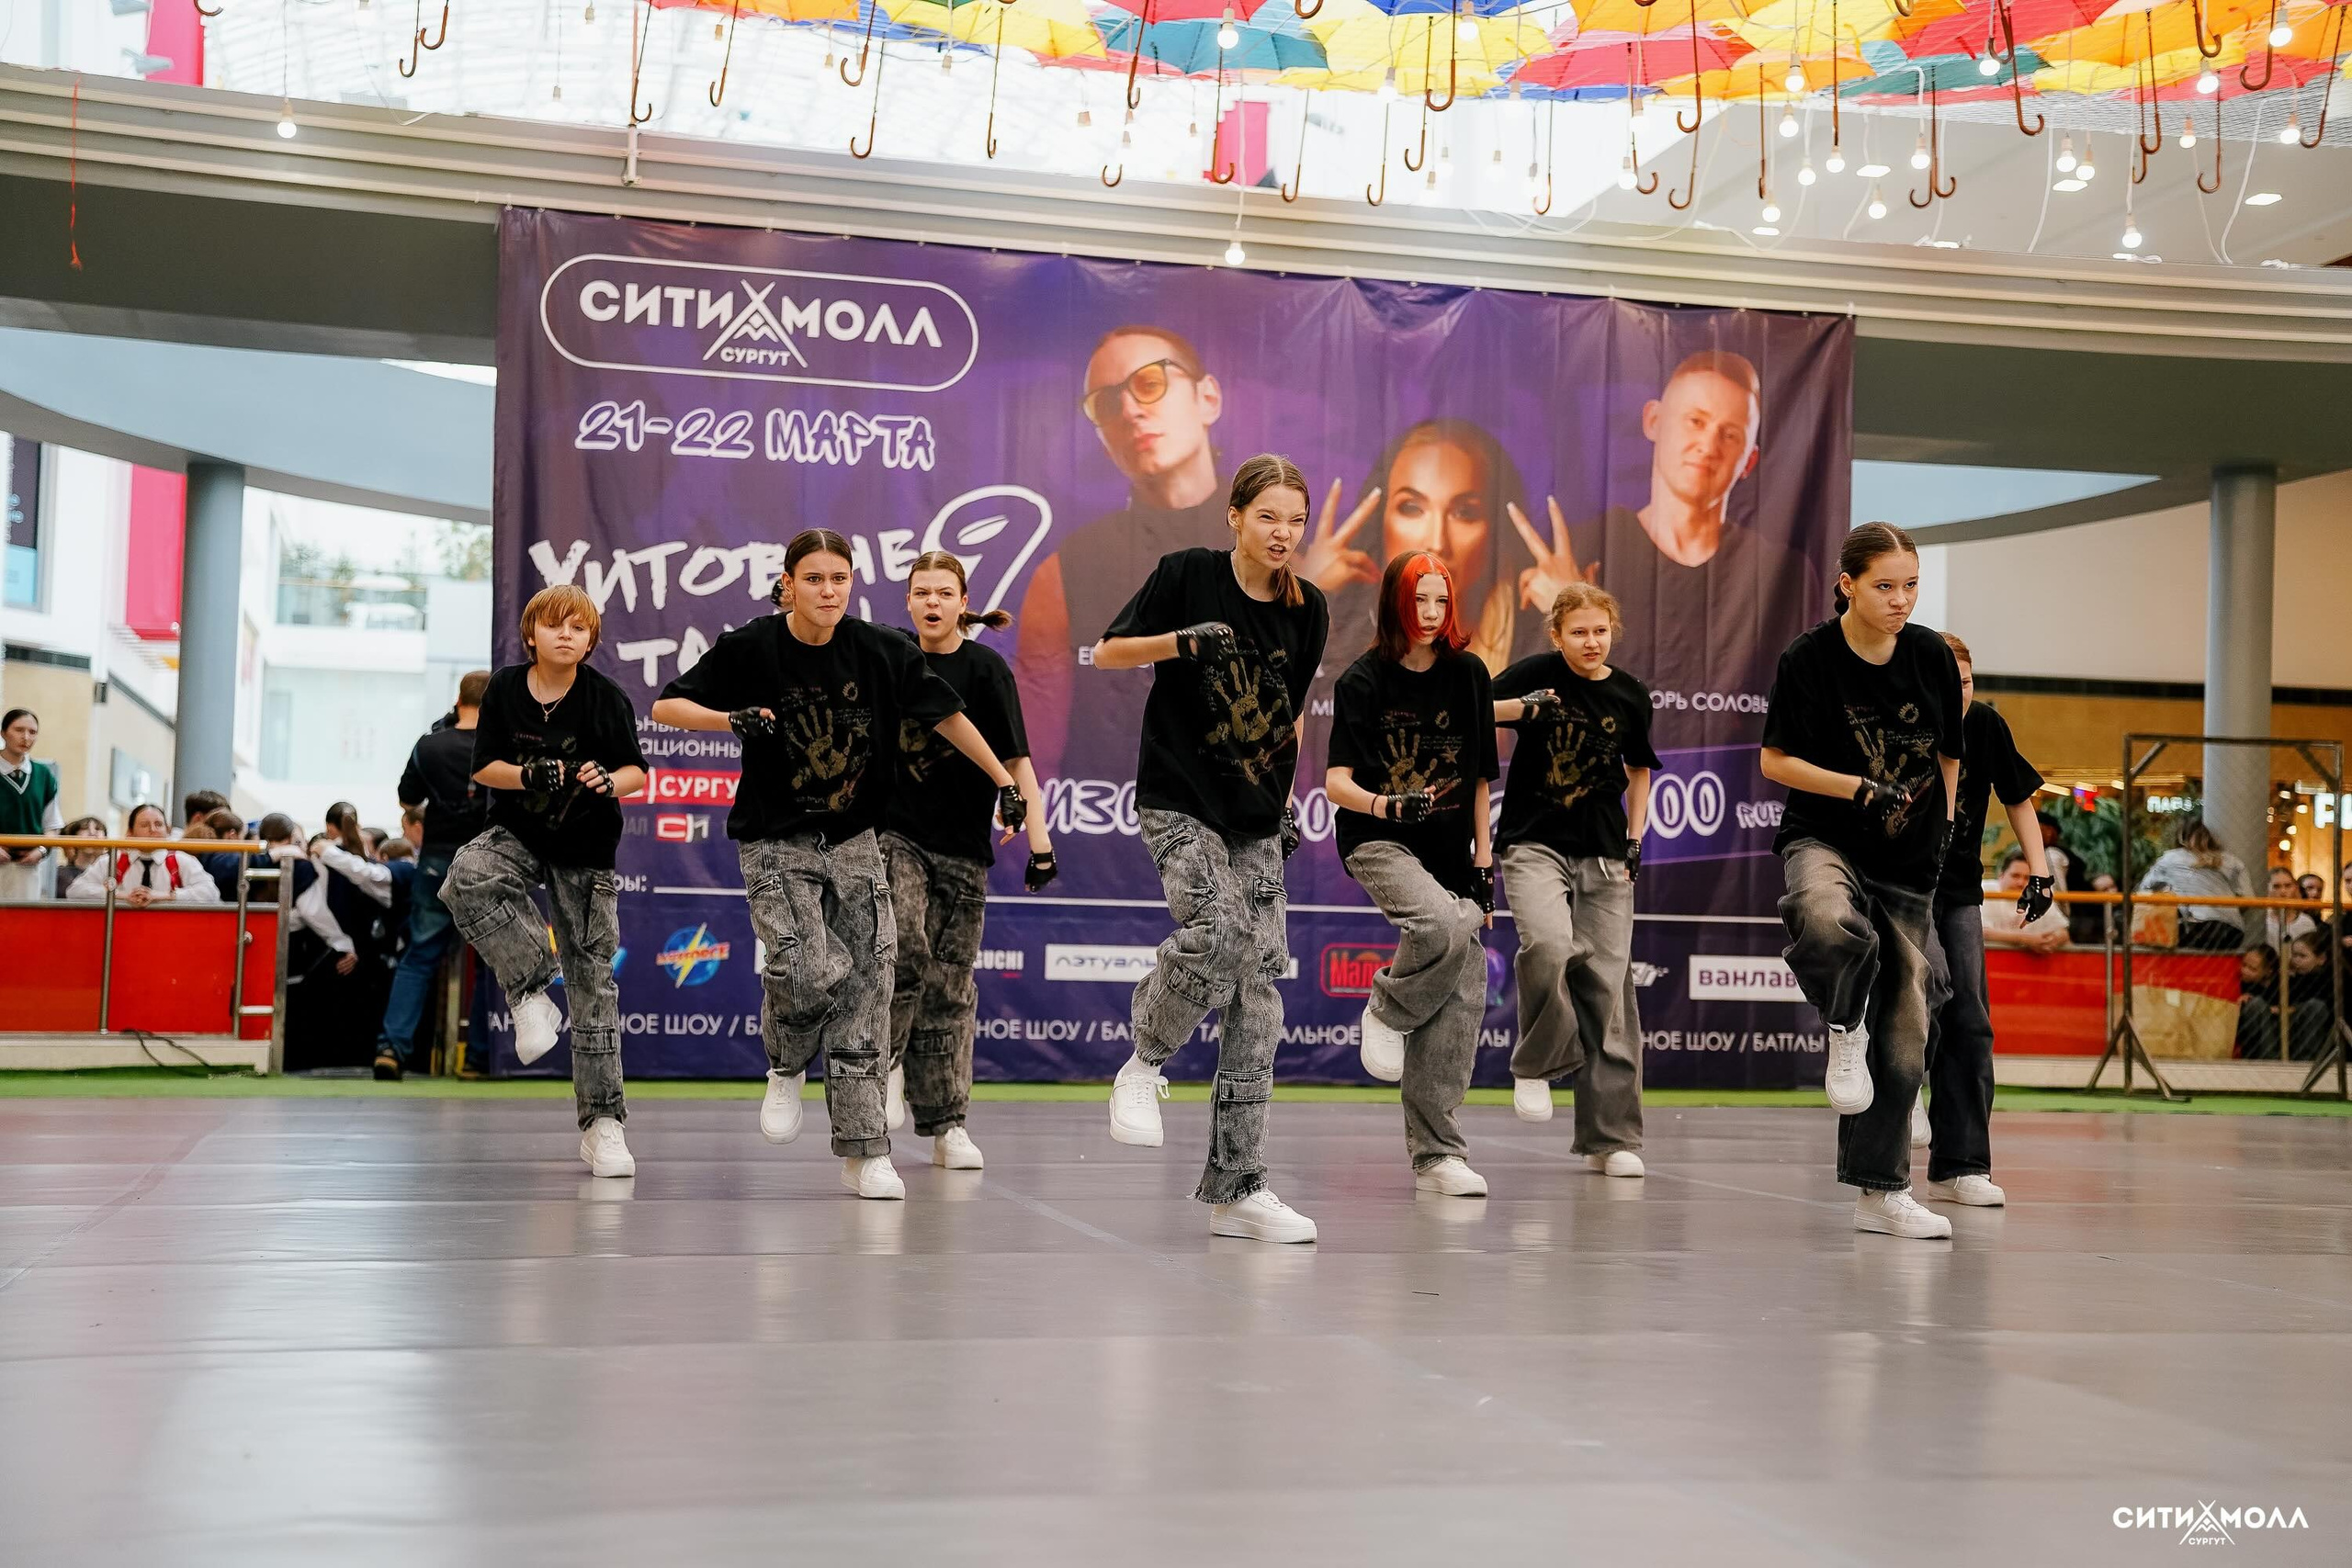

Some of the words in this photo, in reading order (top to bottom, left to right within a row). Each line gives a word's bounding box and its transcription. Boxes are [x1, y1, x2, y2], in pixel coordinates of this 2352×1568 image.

[579, 279, 734, 329] СИТИ
[781, 296, 943, 348] МОЛЛ
[719, 345, 791, 367] СУРГУТ
[574, 400, 755, 459] 21-22
[764, 407, 936, 471] МАРТА
[1649, 690, 1689, 710] ОРЬ
[659, 774, 740, 799] СУРГУ
[664, 1013, 723, 1036] ШОУ
[1025, 1020, 1081, 1041] ШОУ
[1686, 1031, 1736, 1052] ШОУ
[1752, 1032, 1825, 1053] БАТТЛЫ
